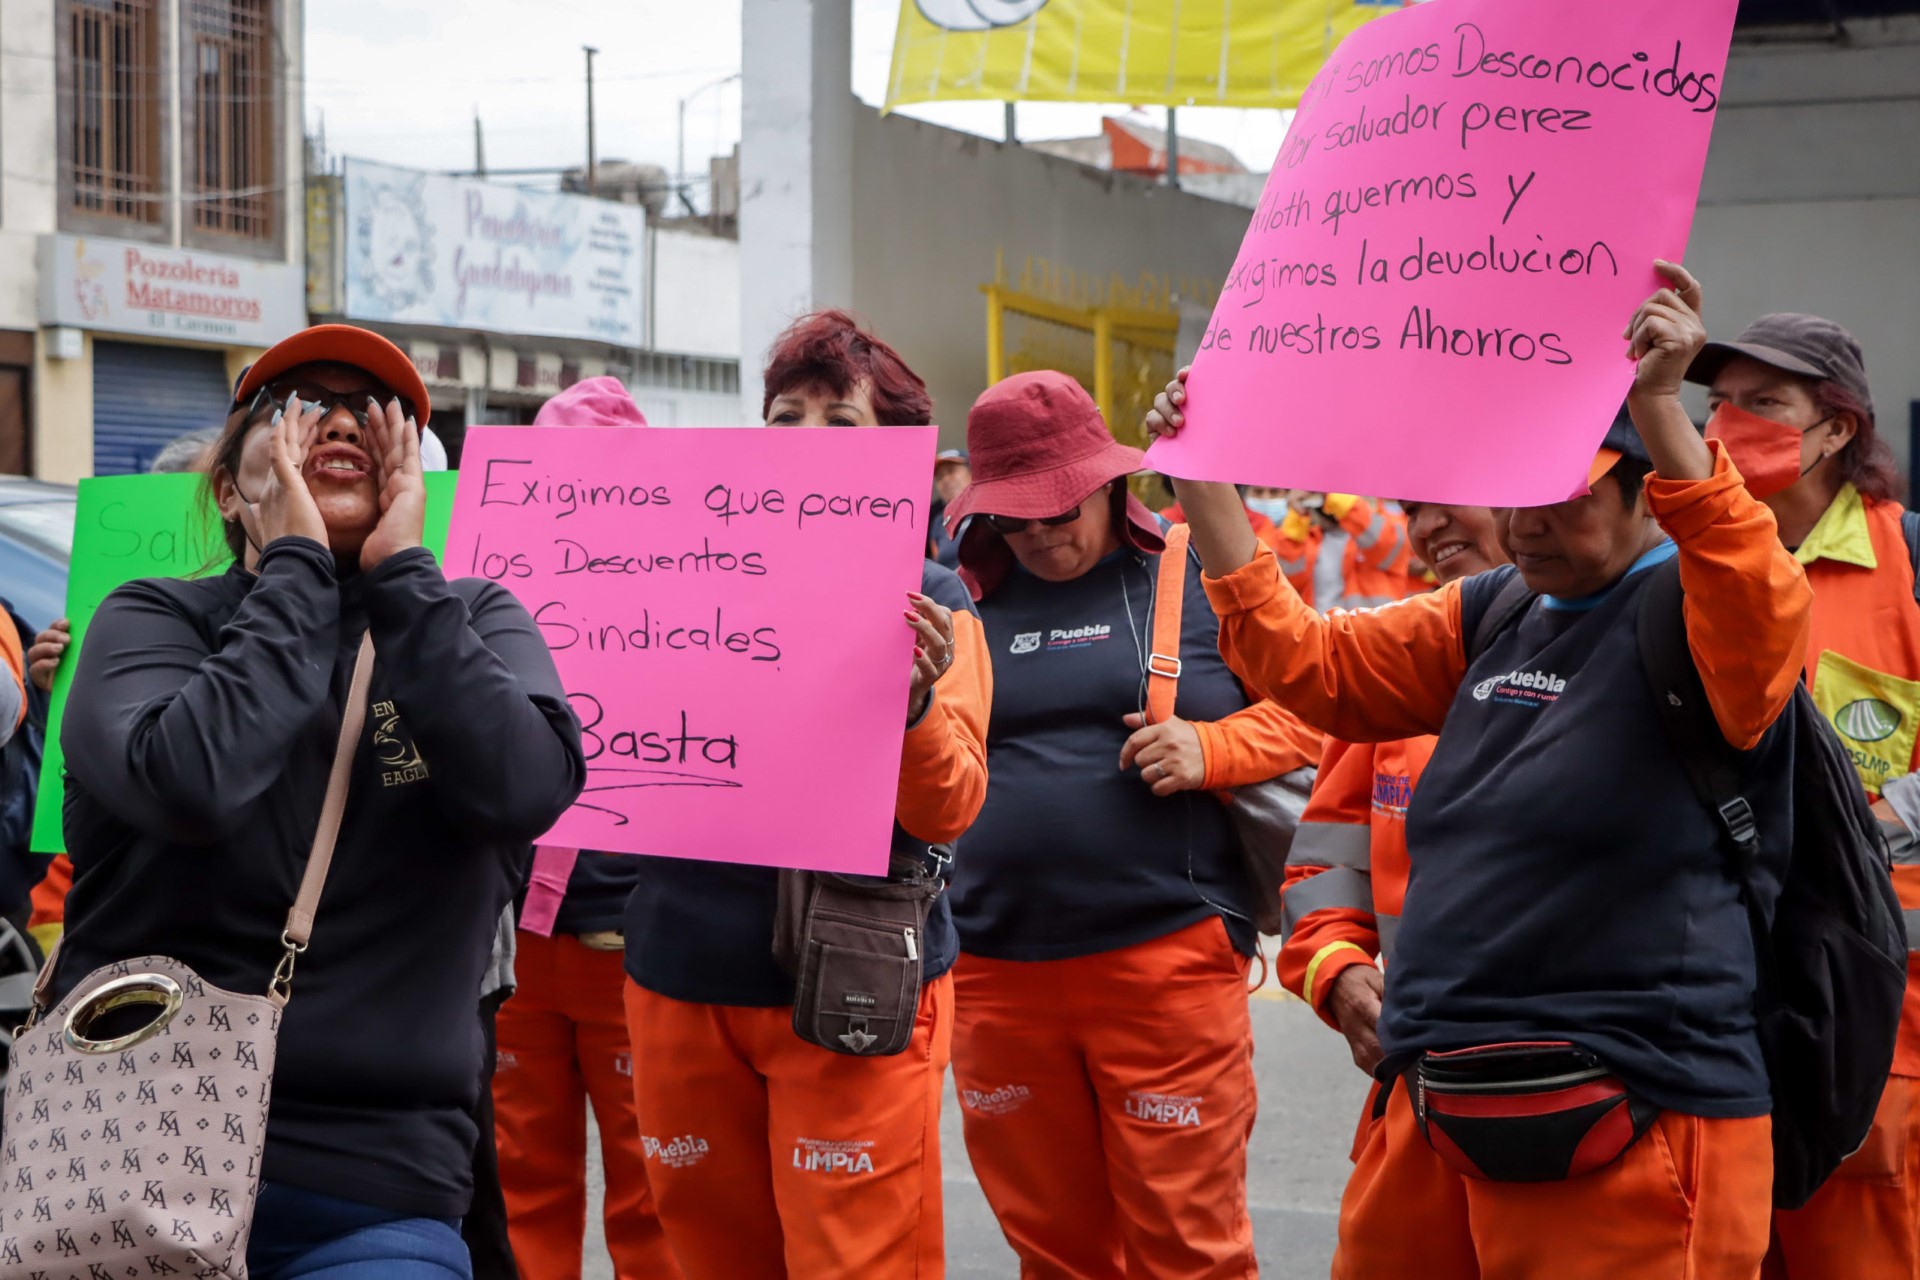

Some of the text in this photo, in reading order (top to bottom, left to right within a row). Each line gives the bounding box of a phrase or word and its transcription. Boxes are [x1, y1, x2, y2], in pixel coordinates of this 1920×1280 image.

[1346, 43, 1441, 93] somos
[1451, 22, 1717, 112] Desconocidos
[1461, 101, 1592, 150] perez
[1322, 171, 1477, 235] quermos
[1357, 239, 1388, 286] la
[126, 280, 262, 321] Matamoros
[1248, 313, 1381, 355] nuestros
[1399, 305, 1573, 365] Ahorros
[479, 459, 915, 530] Exigimos que paren
[471, 532, 768, 580] los Descuentos
[1050, 624, 1111, 641] Puebla
[207, 1005, 233, 1032] KA
[171, 1042, 195, 1070] KA
[234, 1041, 260, 1072] KA
[136, 1080, 158, 1106] KA
[195, 1076, 221, 1103] KA
[101, 1118, 122, 1145] KA
[157, 1111, 182, 1137] KA
[222, 1113, 246, 1145] KA
[120, 1148, 142, 1175] KA
[182, 1146, 208, 1177] KA
[650, 1135, 710, 1158] Puebla
[141, 1181, 168, 1210] KA
[208, 1188, 235, 1218] KA
[55, 1228, 81, 1258] KA
[111, 1219, 137, 1250] KA
[171, 1219, 198, 1243] KA
